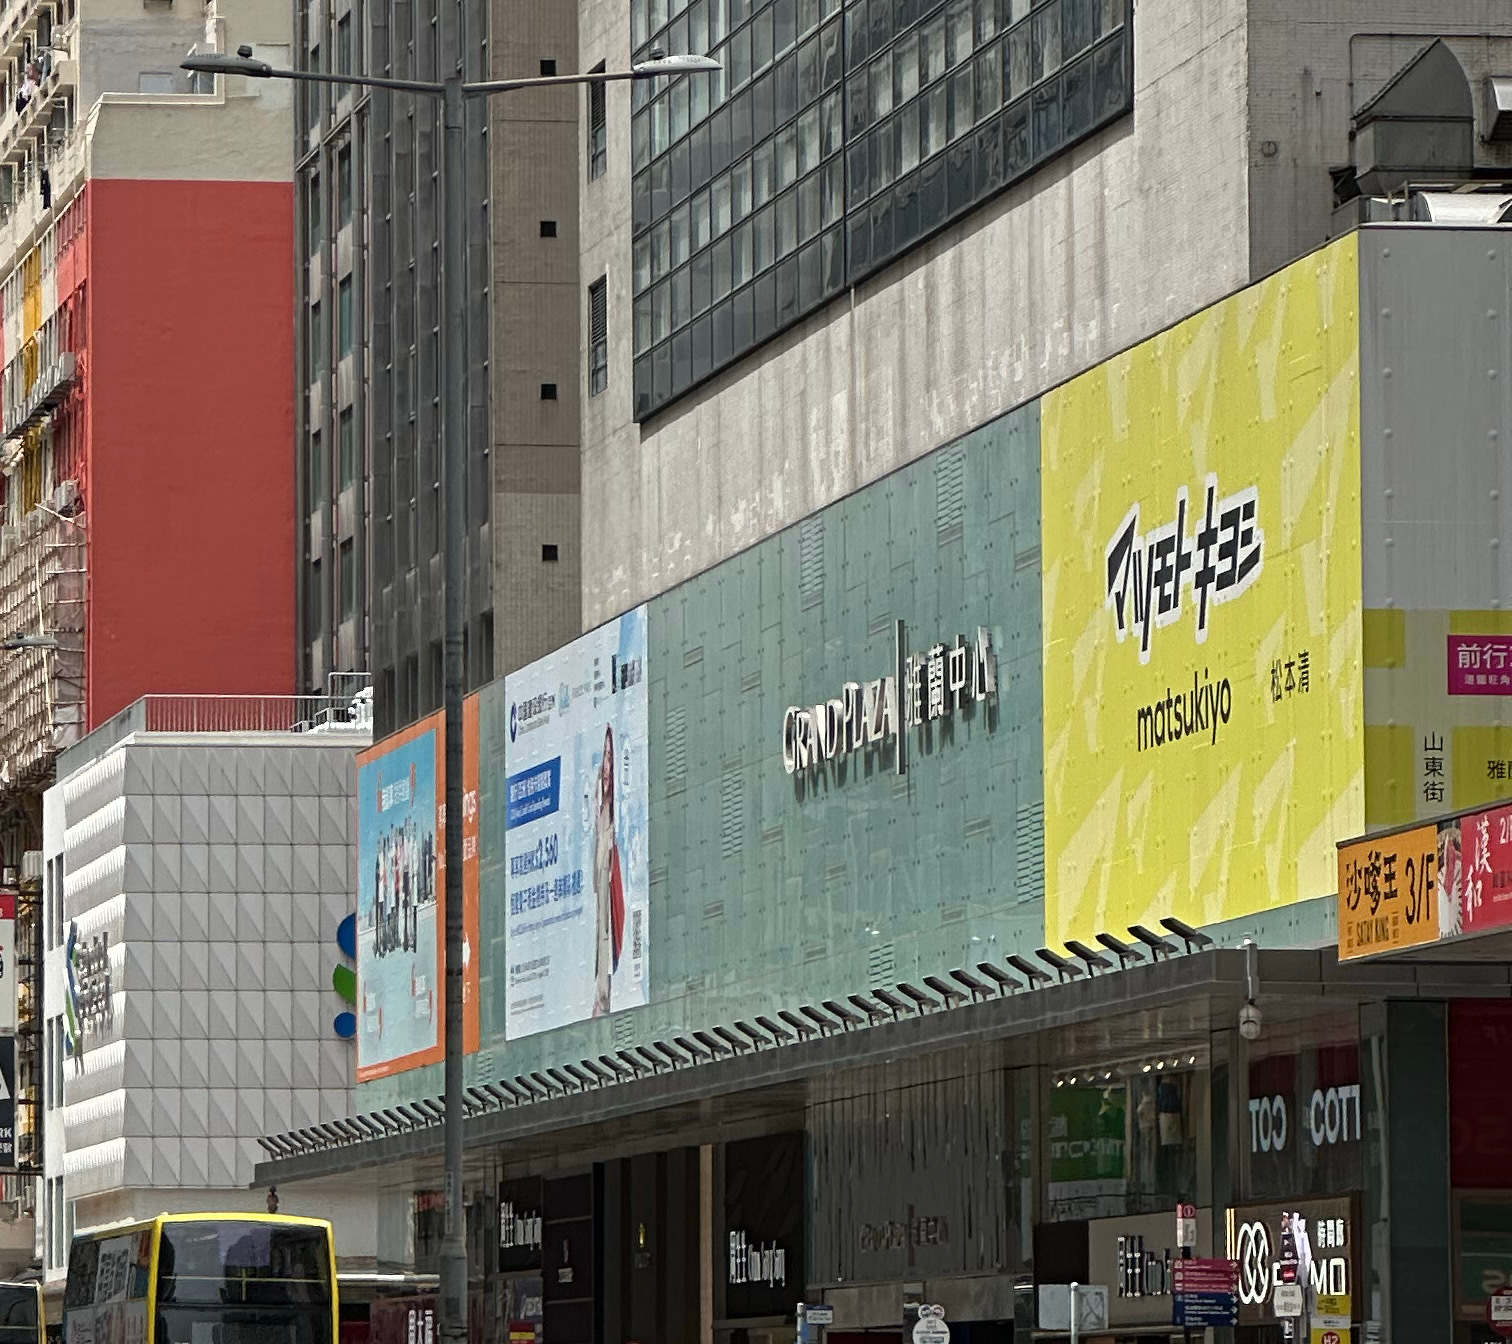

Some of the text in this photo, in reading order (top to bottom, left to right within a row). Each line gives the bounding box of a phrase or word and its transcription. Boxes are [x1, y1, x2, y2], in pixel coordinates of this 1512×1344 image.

[1107, 484, 1262, 654] マツモトキヨシ
[907, 627, 995, 728] 雅蘭中心
[1270, 650, 1310, 703] 松本清
[1457, 643, 1512, 670] 前行
[783, 676, 897, 774] GRAND PLAZA
[1136, 669, 1232, 752] matsukiyo
[1423, 732, 1445, 804] 山東街
[1405, 853, 1435, 925] 3/F
